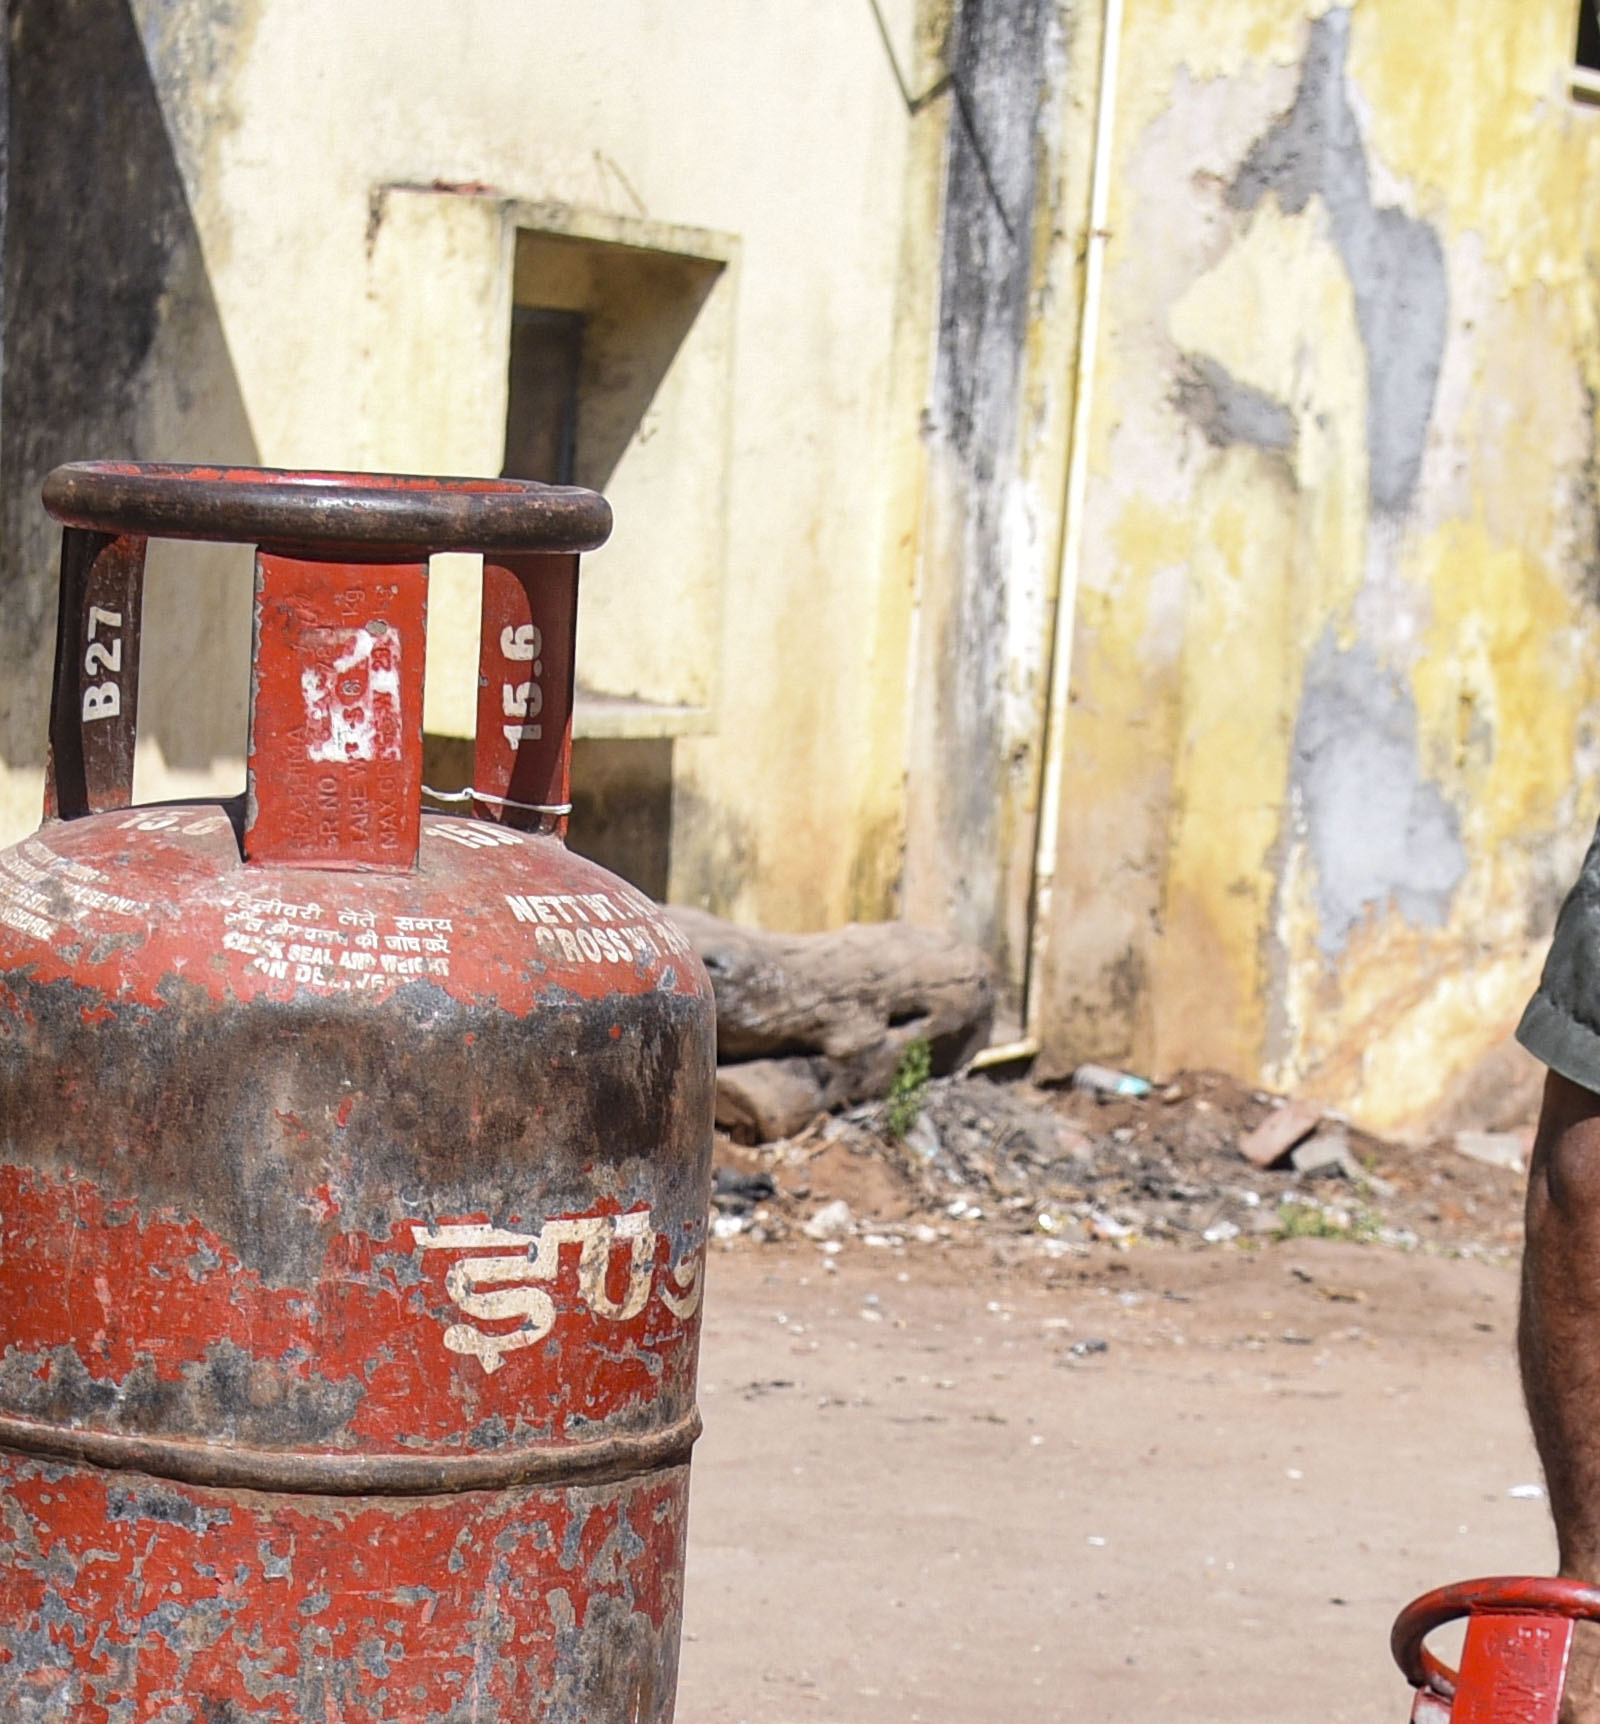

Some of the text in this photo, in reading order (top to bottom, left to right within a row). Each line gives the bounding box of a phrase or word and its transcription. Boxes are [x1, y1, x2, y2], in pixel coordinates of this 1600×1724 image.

[83, 604, 123, 724] B27
[500, 624, 543, 751] 15.6
[287, 943, 334, 966] SEAL
[338, 951, 378, 972] AND
